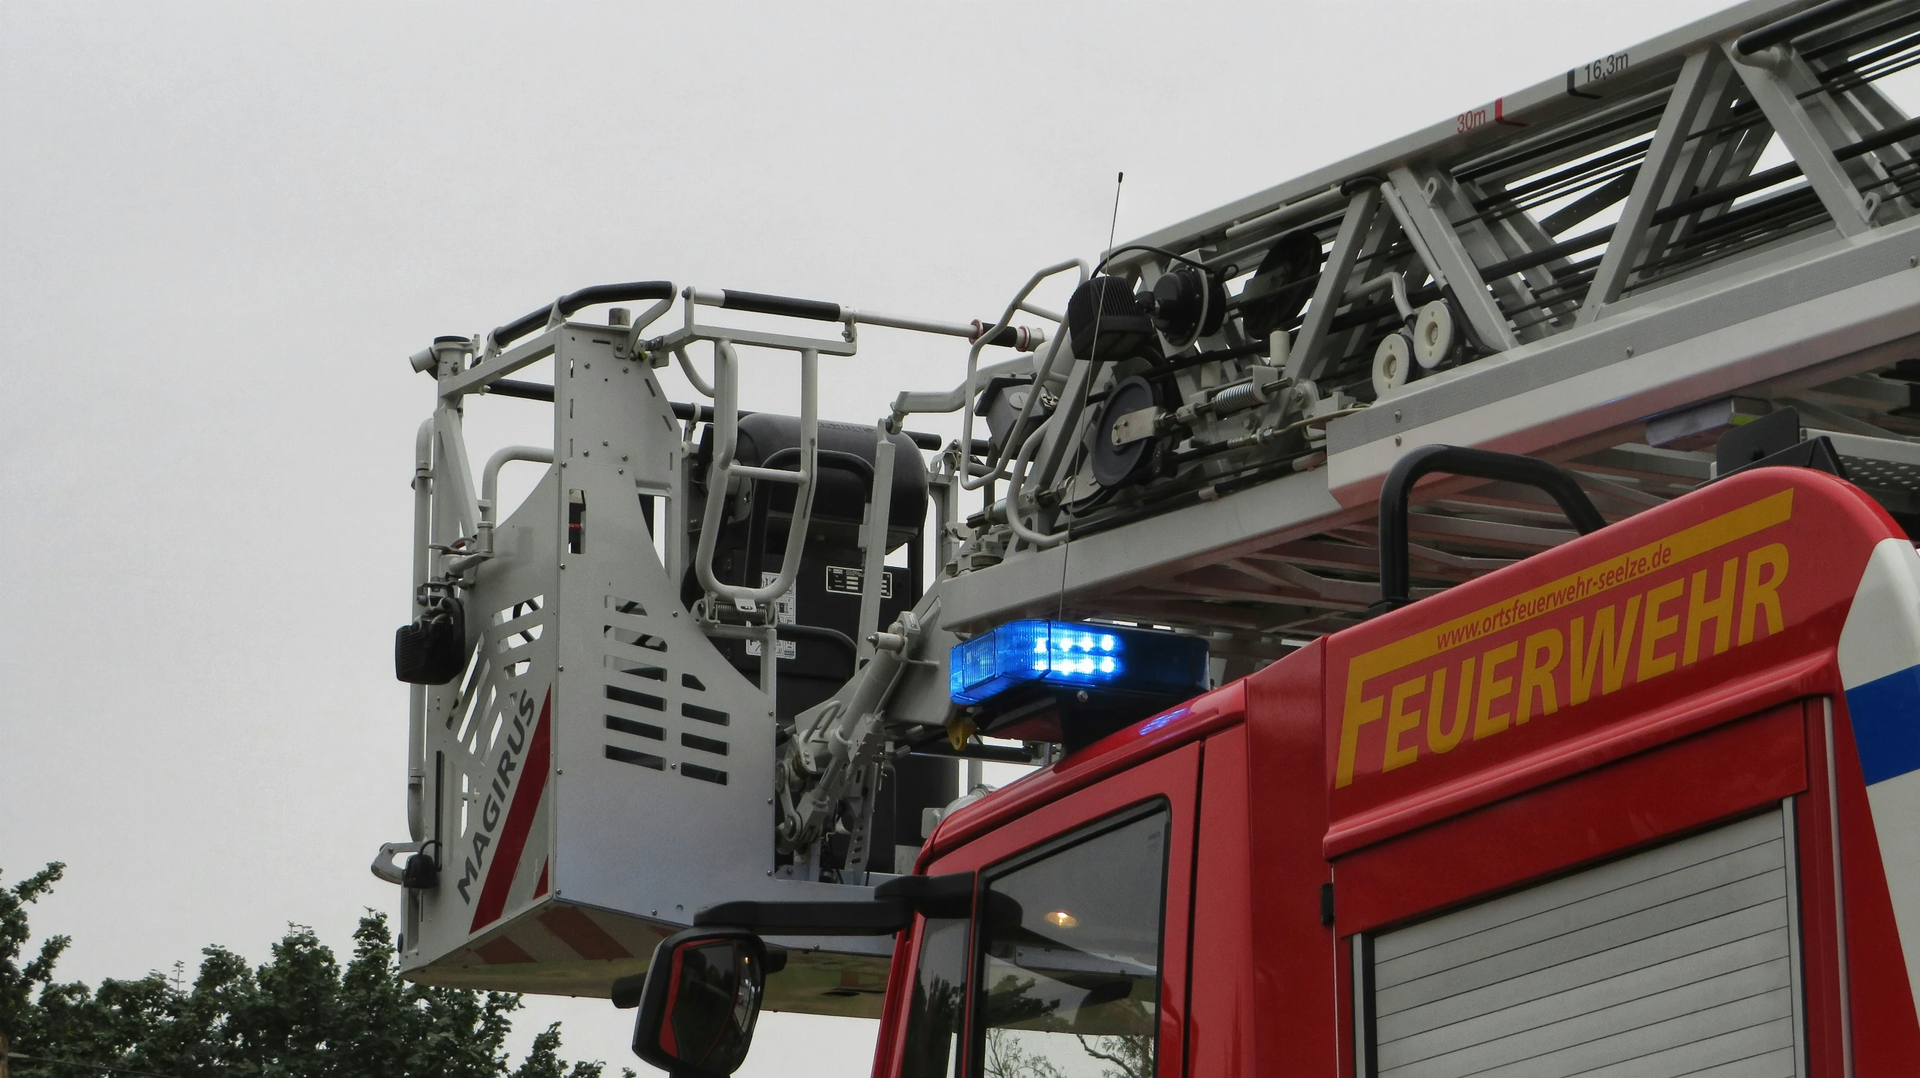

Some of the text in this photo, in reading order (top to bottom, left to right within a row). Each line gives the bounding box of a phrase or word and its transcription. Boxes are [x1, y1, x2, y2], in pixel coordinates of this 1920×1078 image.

[1584, 53, 1629, 82] 16,3m
[1456, 109, 1486, 134] 30m
[1437, 544, 1672, 650] www.ortsfeuerwehr-seelze.de
[1335, 541, 1790, 790] FEUERWEHR
[457, 689, 535, 905] MAGIRUS
